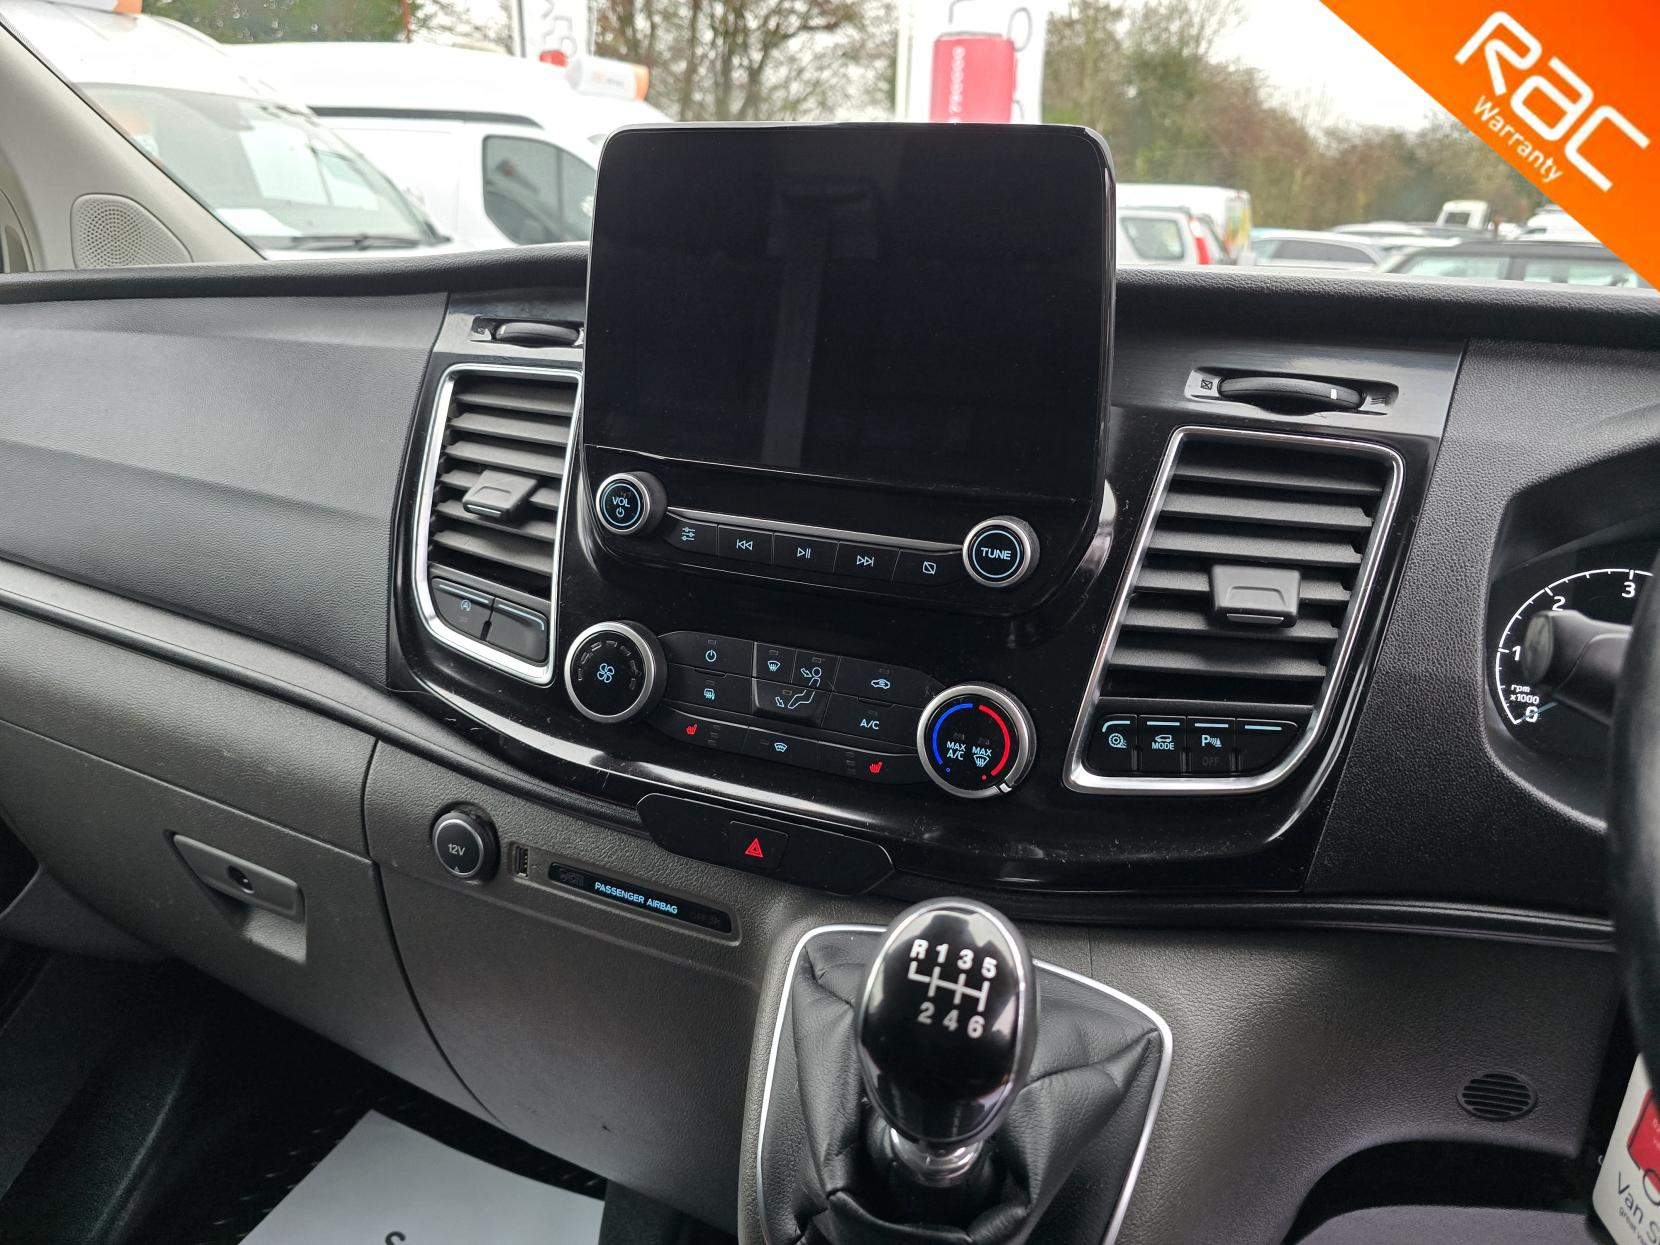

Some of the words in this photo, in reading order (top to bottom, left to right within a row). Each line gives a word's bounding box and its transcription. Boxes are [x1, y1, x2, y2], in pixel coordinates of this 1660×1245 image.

[612, 496, 631, 508] VOL
[980, 547, 1012, 561] TUNE
[1621, 581, 1636, 598] 3
[1551, 595, 1566, 611] 2
[1511, 646, 1521, 661] 1
[1510, 684, 1531, 694] rpm
[1509, 693, 1540, 705] x1000
[860, 718, 880, 730] A/C
[946, 741, 966, 752] MAX
[971, 746, 993, 757] MAX
[1151, 741, 1175, 750] MODE
[946, 749, 965, 761] A/C
[1201, 756, 1220, 767] OFF
[447, 843, 466, 856] 12V
[594, 881, 645, 904] PASSENGER
[646, 898, 678, 914] AIRBAG
[909, 938, 929, 960] R
[935, 943, 950, 964] 1
[957, 948, 975, 970] 3
[981, 956, 998, 979] 5
[917, 1001, 936, 1025] 2
[942, 1009, 960, 1031] 4
[967, 1015, 986, 1039] 6
[1618, 1171, 1644, 1225] Van
